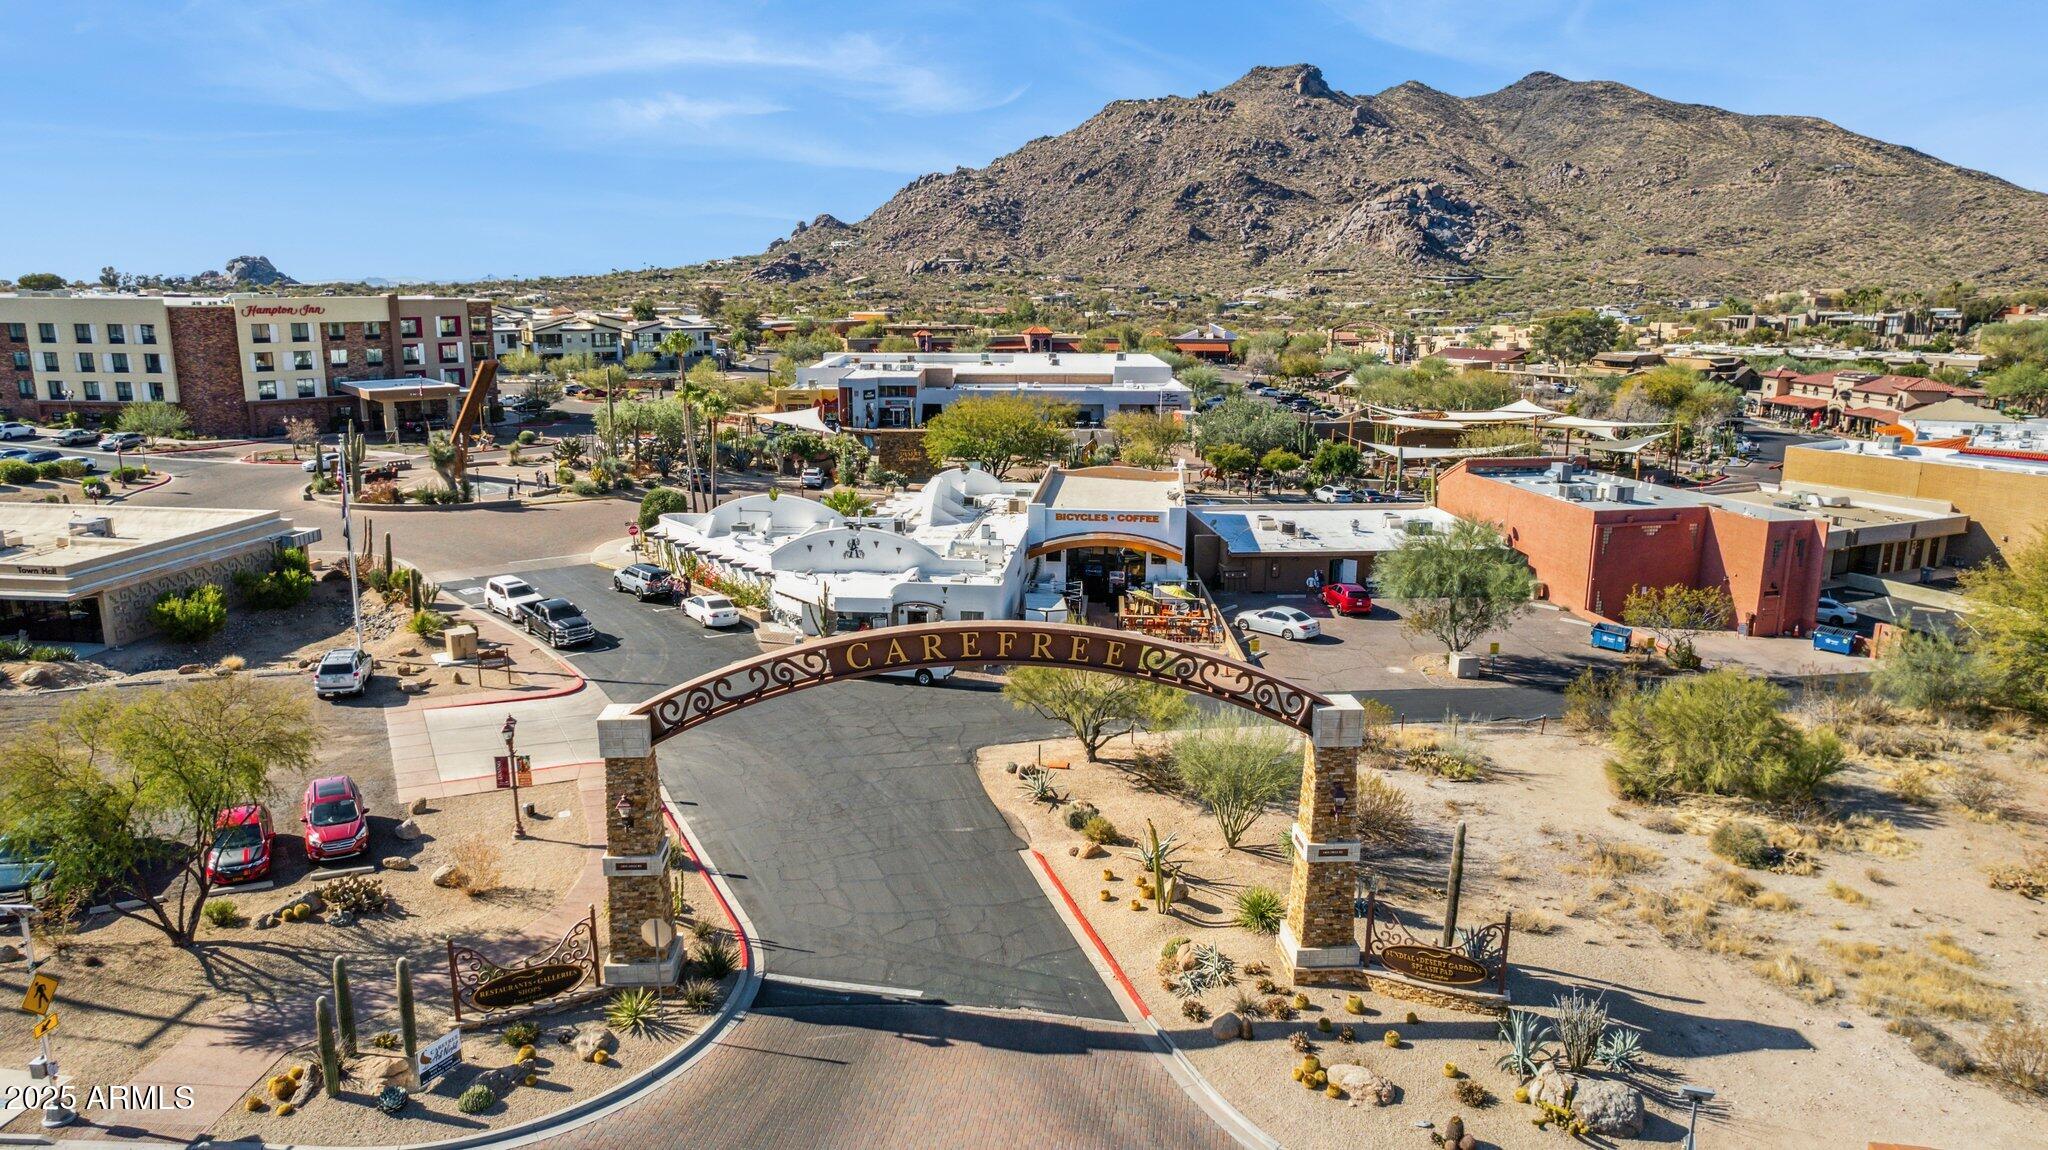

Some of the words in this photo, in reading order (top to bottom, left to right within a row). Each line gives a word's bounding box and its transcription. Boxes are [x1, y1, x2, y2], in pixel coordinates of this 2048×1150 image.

[241, 304, 298, 317] Hampton
[300, 303, 325, 316] Inn
[1055, 512, 1109, 522] BICYCLES
[1116, 513, 1160, 523] COFFEE
[16, 566, 39, 574] Town
[41, 567, 58, 575] Hall
[846, 631, 1127, 670] CAREFREE
[1386, 950, 1416, 962] SUNDIAL
[1420, 957, 1447, 968] DESERT
[1448, 962, 1483, 974] GARDENS
[1411, 962, 1438, 973] SPLASH
[1440, 968, 1454, 976] PAD
[480, 980, 533, 998] RESTAURANTS
[537, 969, 579, 985] GALLERIES
[518, 985, 542, 996] SHOPS
